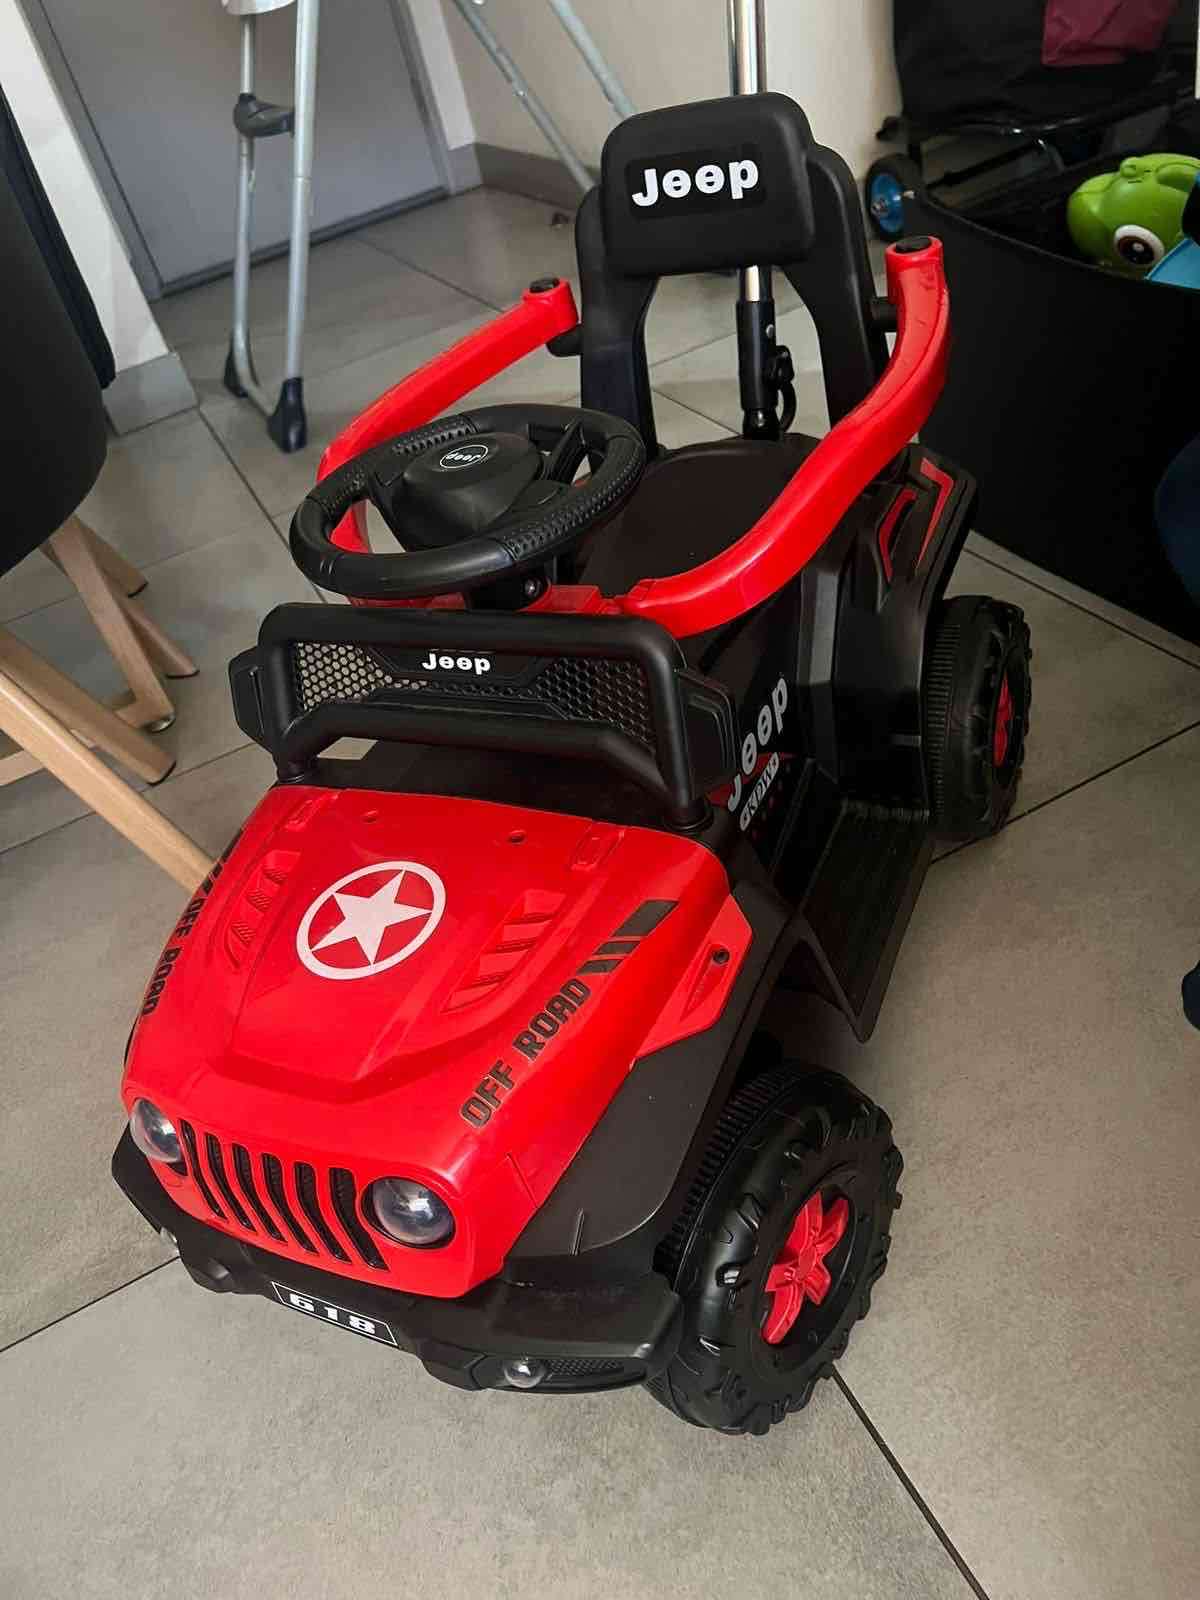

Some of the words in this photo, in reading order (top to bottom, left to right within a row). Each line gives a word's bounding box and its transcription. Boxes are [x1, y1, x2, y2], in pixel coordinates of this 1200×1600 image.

[631, 159, 759, 207] Jeep
[445, 452, 482, 462] Jeep
[421, 653, 491, 675] Jeep
[727, 677, 788, 813] Jeep
[459, 1058, 516, 1129] OFF
[511, 977, 592, 1062] ROAD
[289, 1292, 376, 1335] 618
